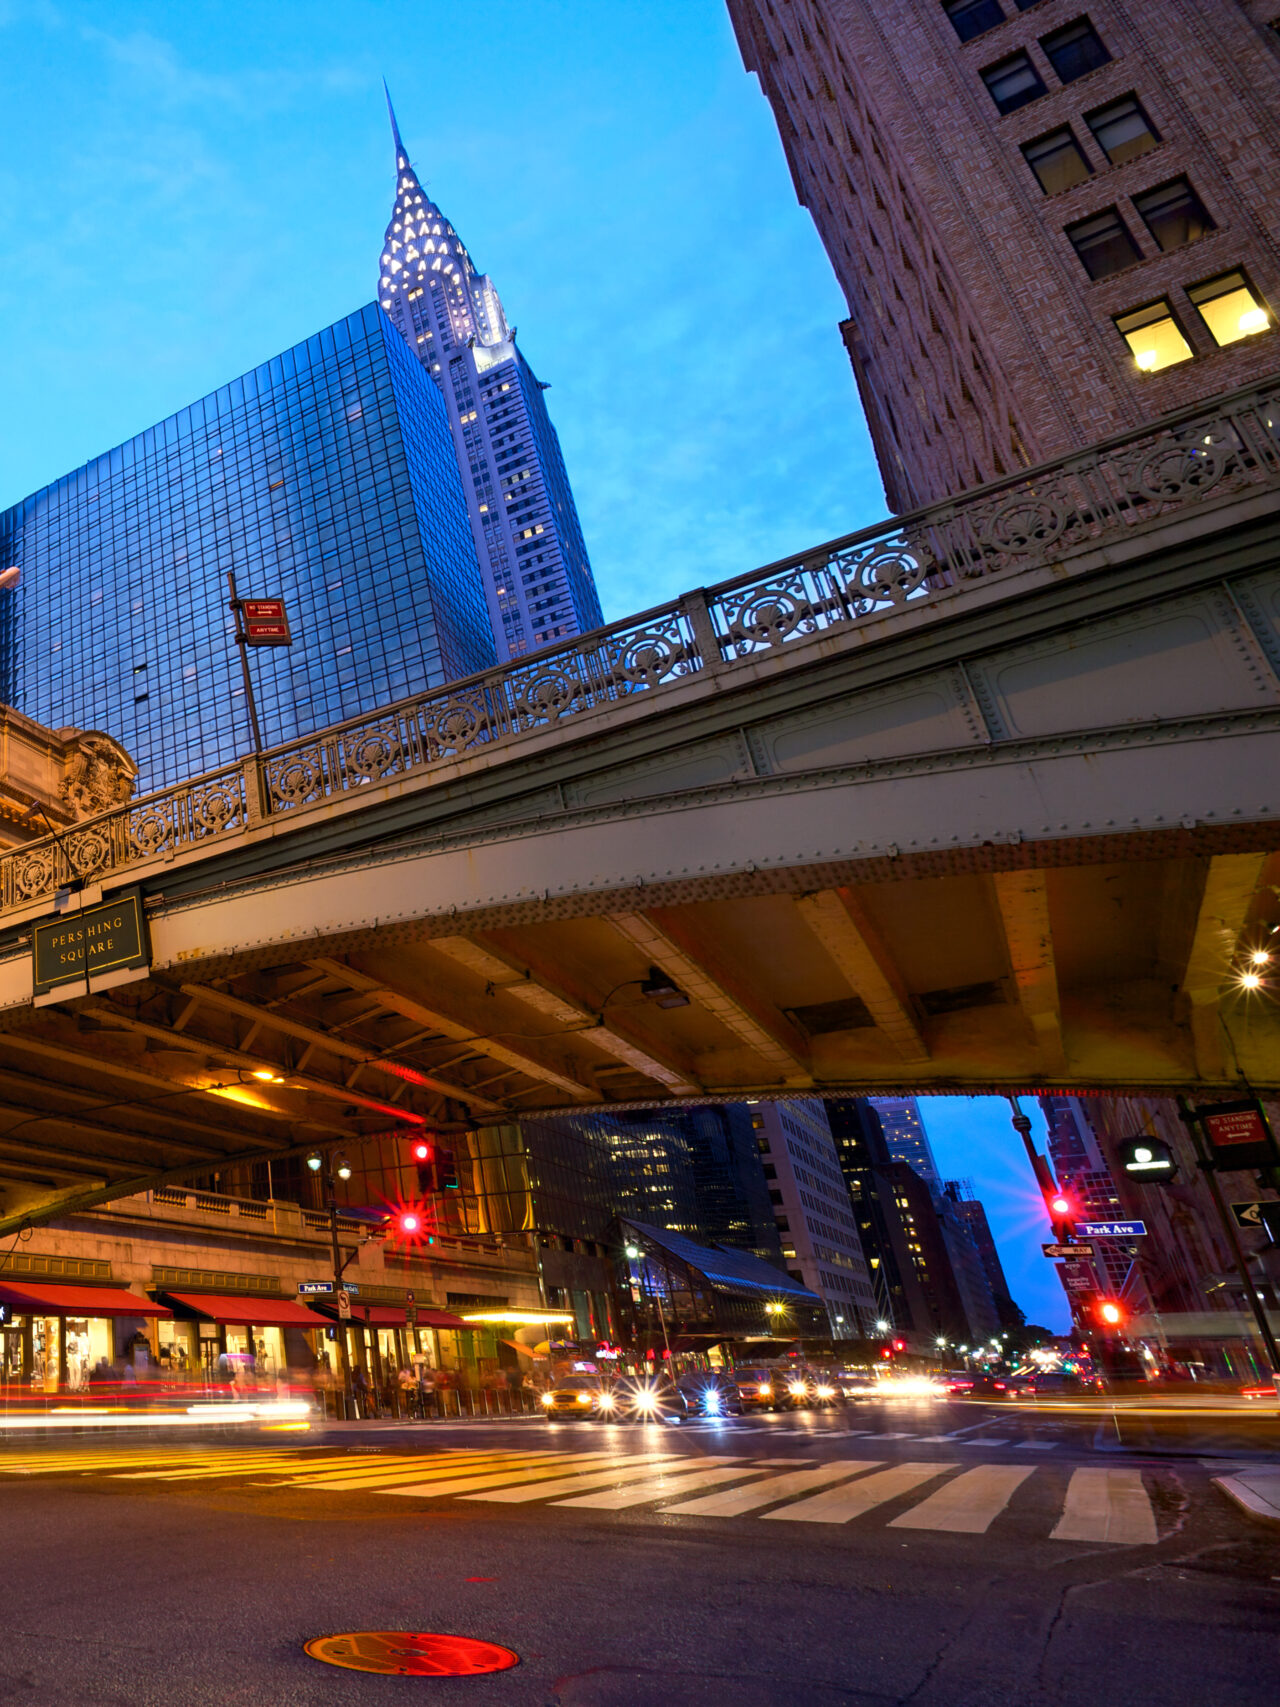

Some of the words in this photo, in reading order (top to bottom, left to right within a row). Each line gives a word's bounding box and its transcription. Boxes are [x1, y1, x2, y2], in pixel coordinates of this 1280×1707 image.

[52, 917, 122, 948] PERSHING
[60, 938, 114, 964] SQUARE
[1223, 1114, 1257, 1124] STANDING
[1218, 1123, 1254, 1132] ANYTIME
[1086, 1225, 1111, 1234] Park
[1113, 1224, 1134, 1233] Ave
